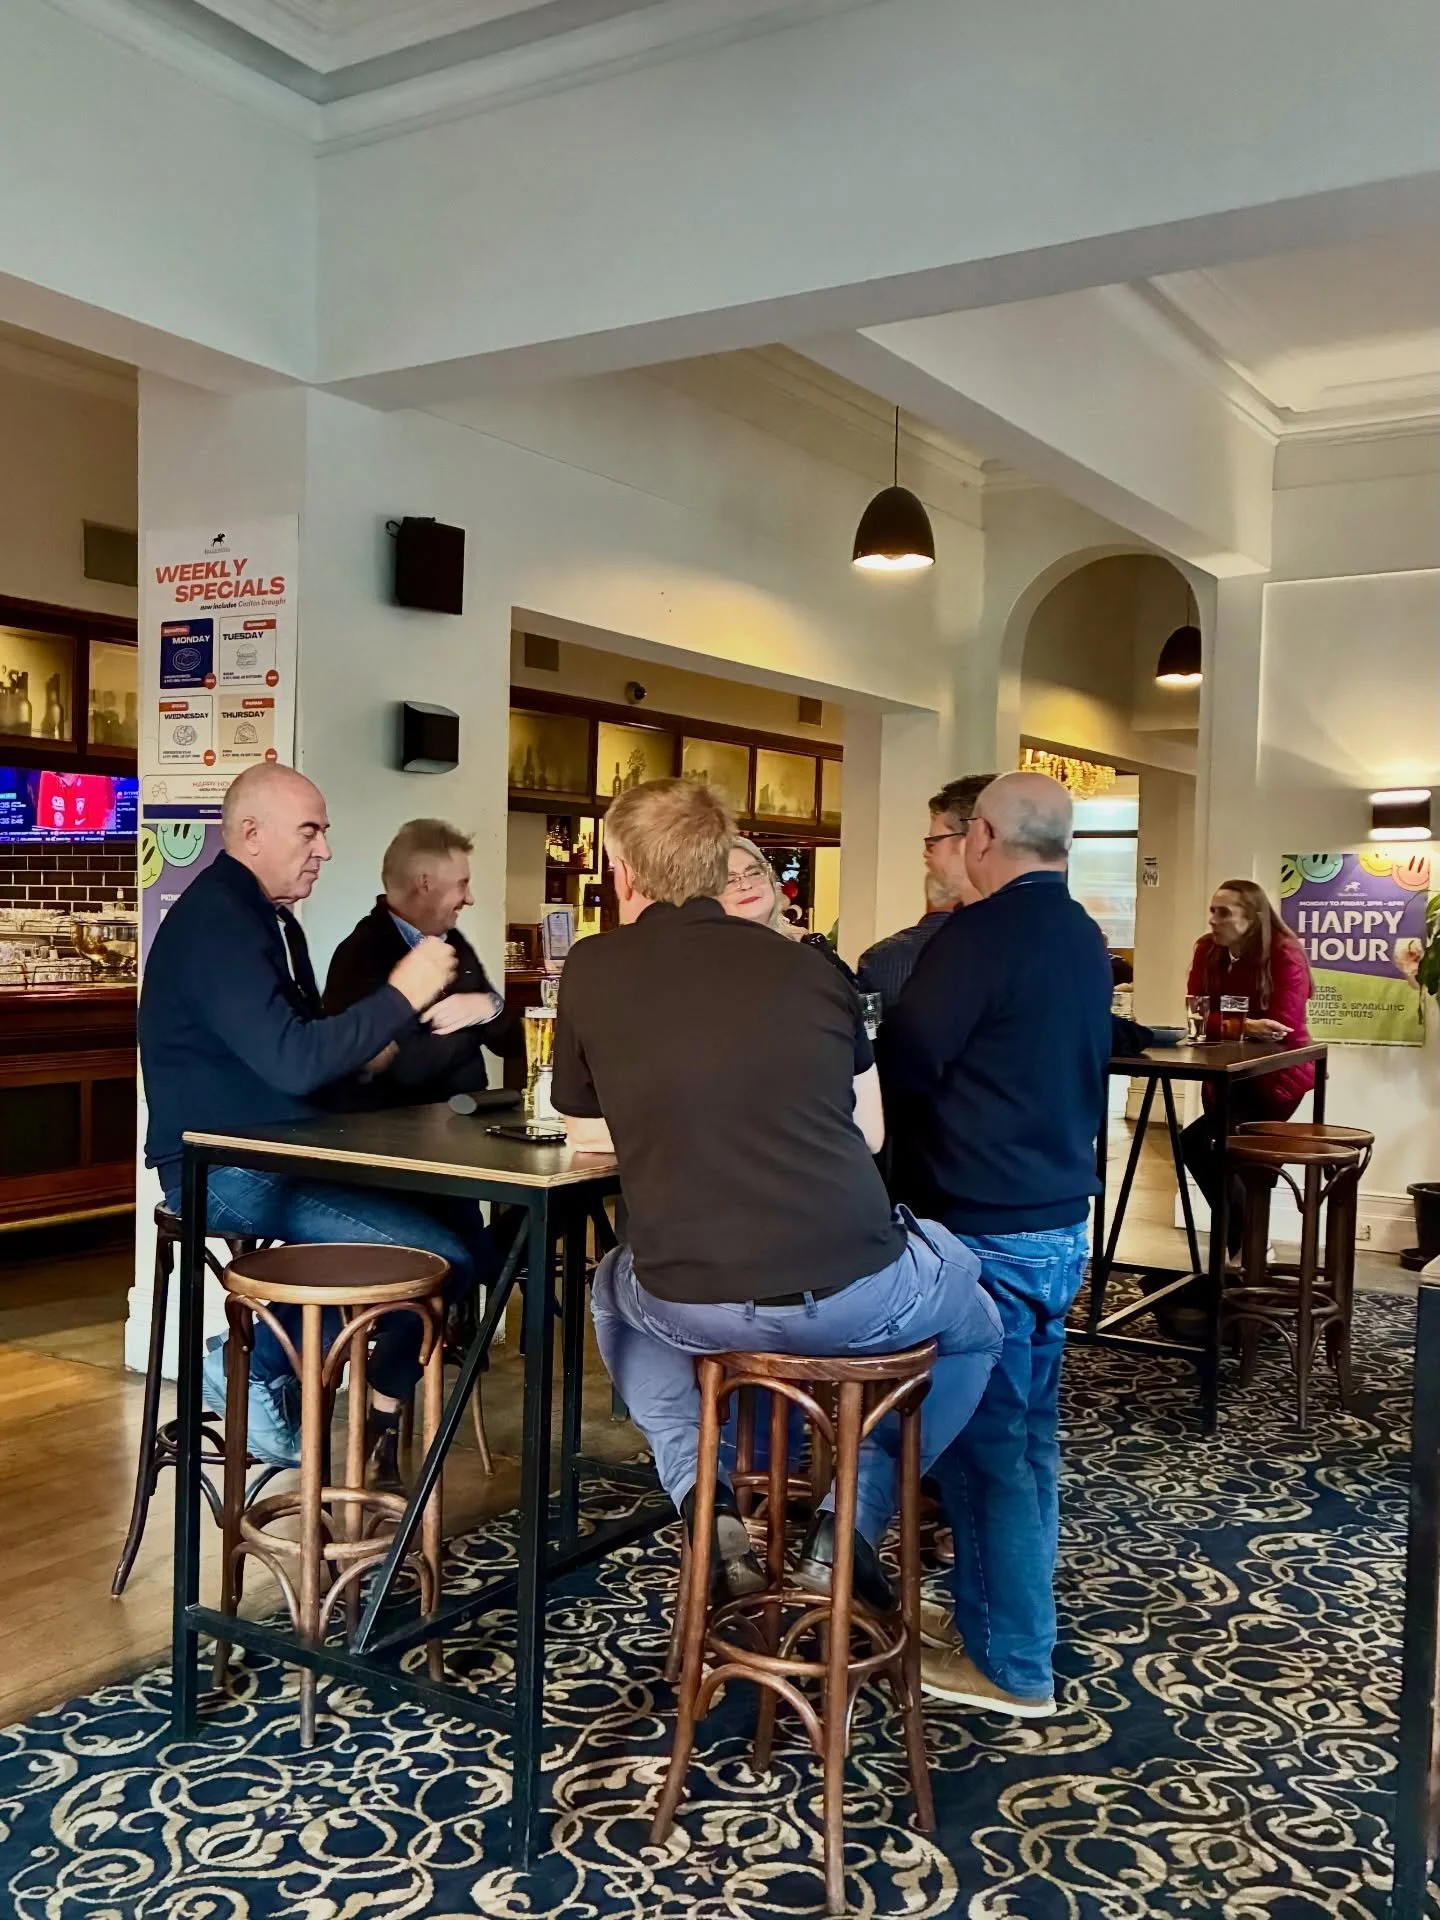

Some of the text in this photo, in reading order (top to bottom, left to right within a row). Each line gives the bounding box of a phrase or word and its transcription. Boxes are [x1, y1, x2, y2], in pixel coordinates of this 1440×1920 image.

[156, 558, 248, 584] WEEKLY
[175, 576, 285, 603] SPECIALS
[213, 602, 237, 610] includes
[261, 598, 286, 607] Draught
[172, 635, 211, 645] MONDAY
[222, 631, 264, 641] TUESDAY
[164, 712, 209, 720] WEDNESDAY
[221, 710, 266, 719] THURSDAY
[1298, 910, 1404, 934] HAPPY
[1298, 938, 1391, 962] HOUR
[1314, 985, 1336, 993] EERS
[1314, 993, 1343, 1001] IDERS
[1309, 1001, 1339, 1010] WINES
[1350, 1002, 1405, 1012] SPARKLING
[1309, 1009, 1374, 1019] BASIC SPIRITS
